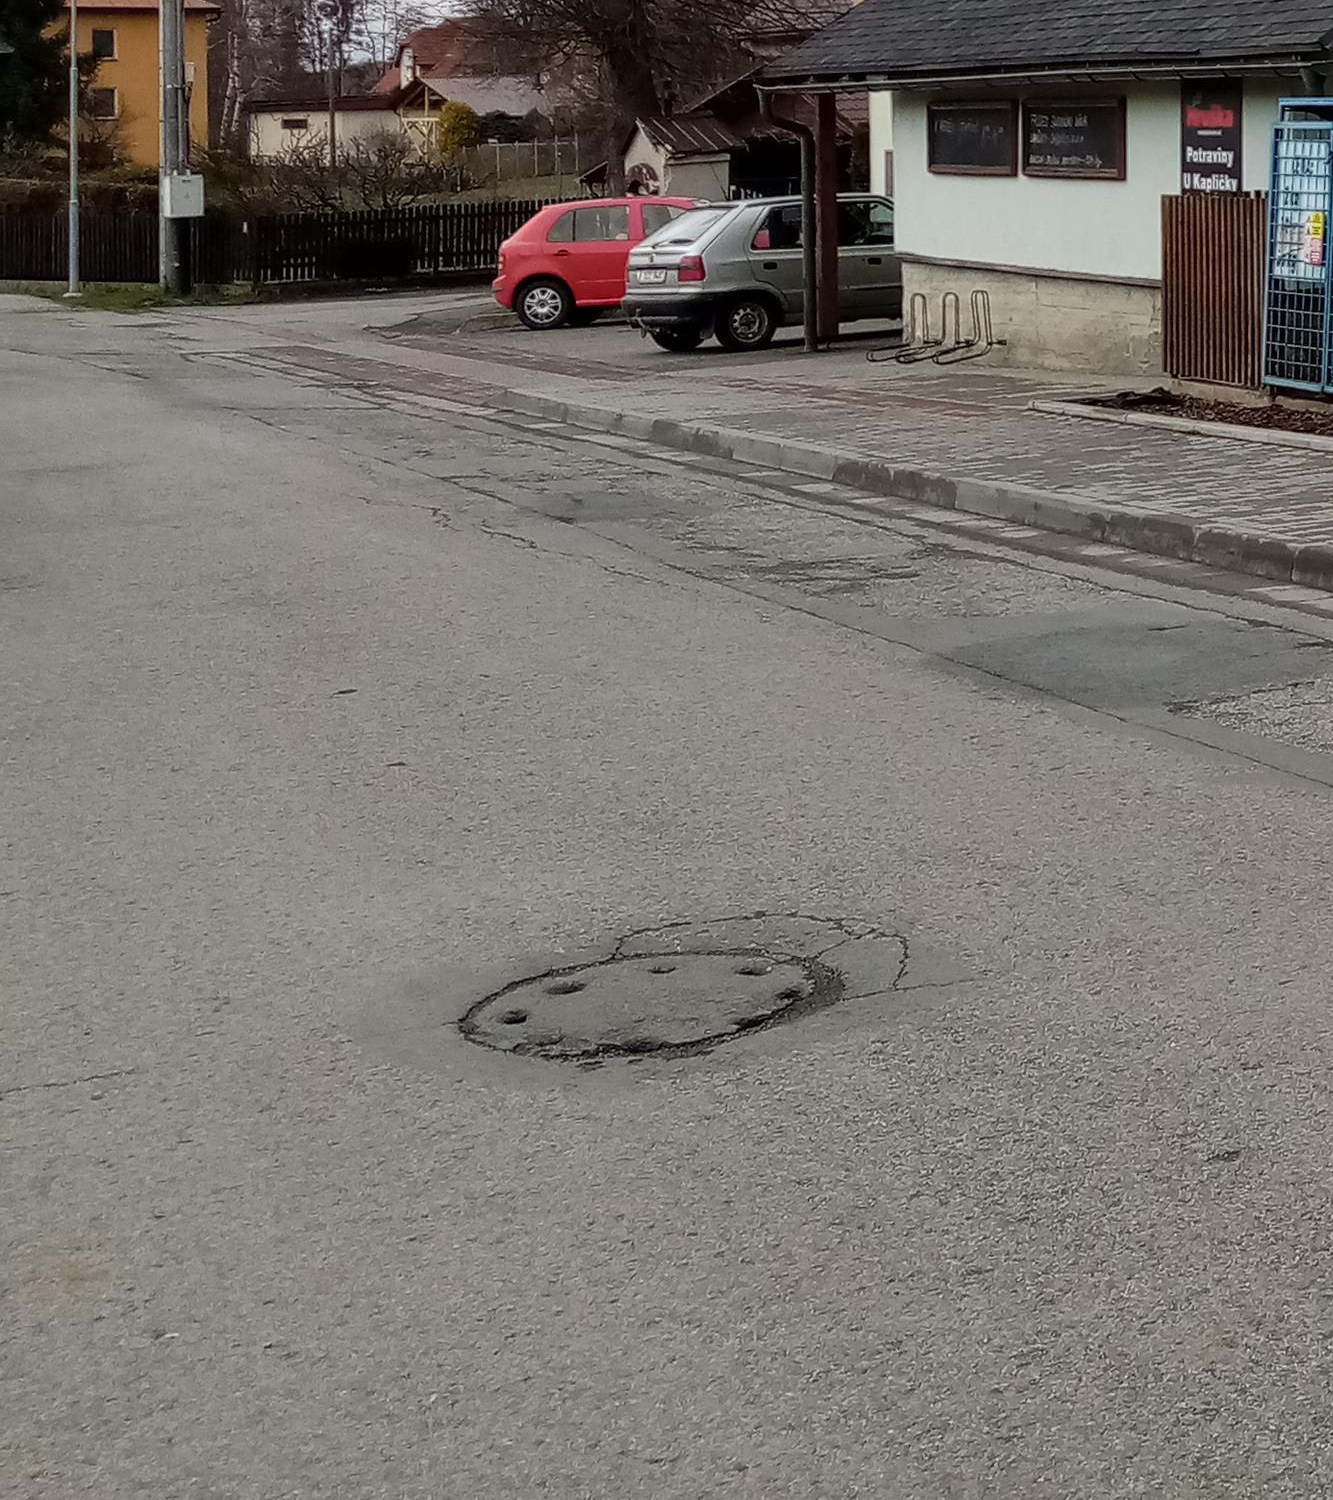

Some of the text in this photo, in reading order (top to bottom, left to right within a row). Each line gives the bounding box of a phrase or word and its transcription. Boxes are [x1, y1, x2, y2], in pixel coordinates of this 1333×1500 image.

[1186, 146, 1234, 168] Potraviny
[1183, 172, 1238, 192] U Kapličky
